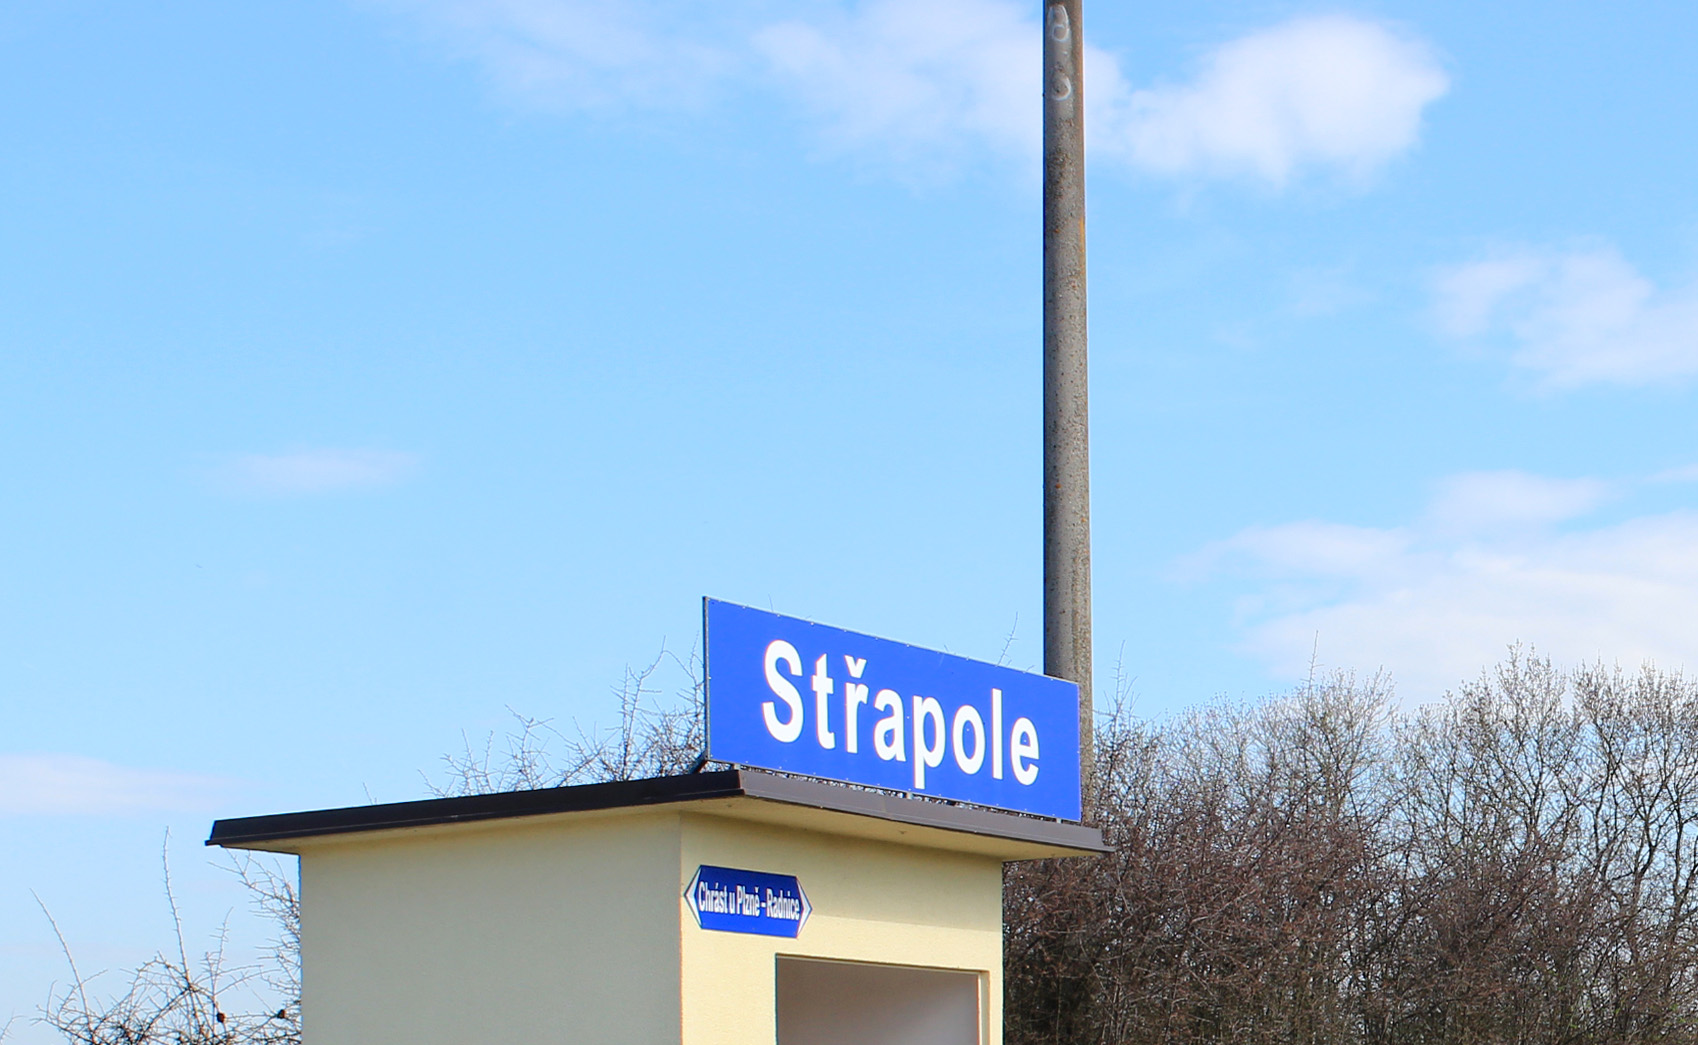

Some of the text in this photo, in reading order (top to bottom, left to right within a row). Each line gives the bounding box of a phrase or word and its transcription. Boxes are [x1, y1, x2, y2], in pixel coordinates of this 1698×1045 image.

[762, 639, 1040, 790] Střapole
[699, 881, 728, 913] Chrást
[729, 892, 736, 914] u
[736, 885, 760, 916] Plzně
[766, 887, 800, 920] Radnice
